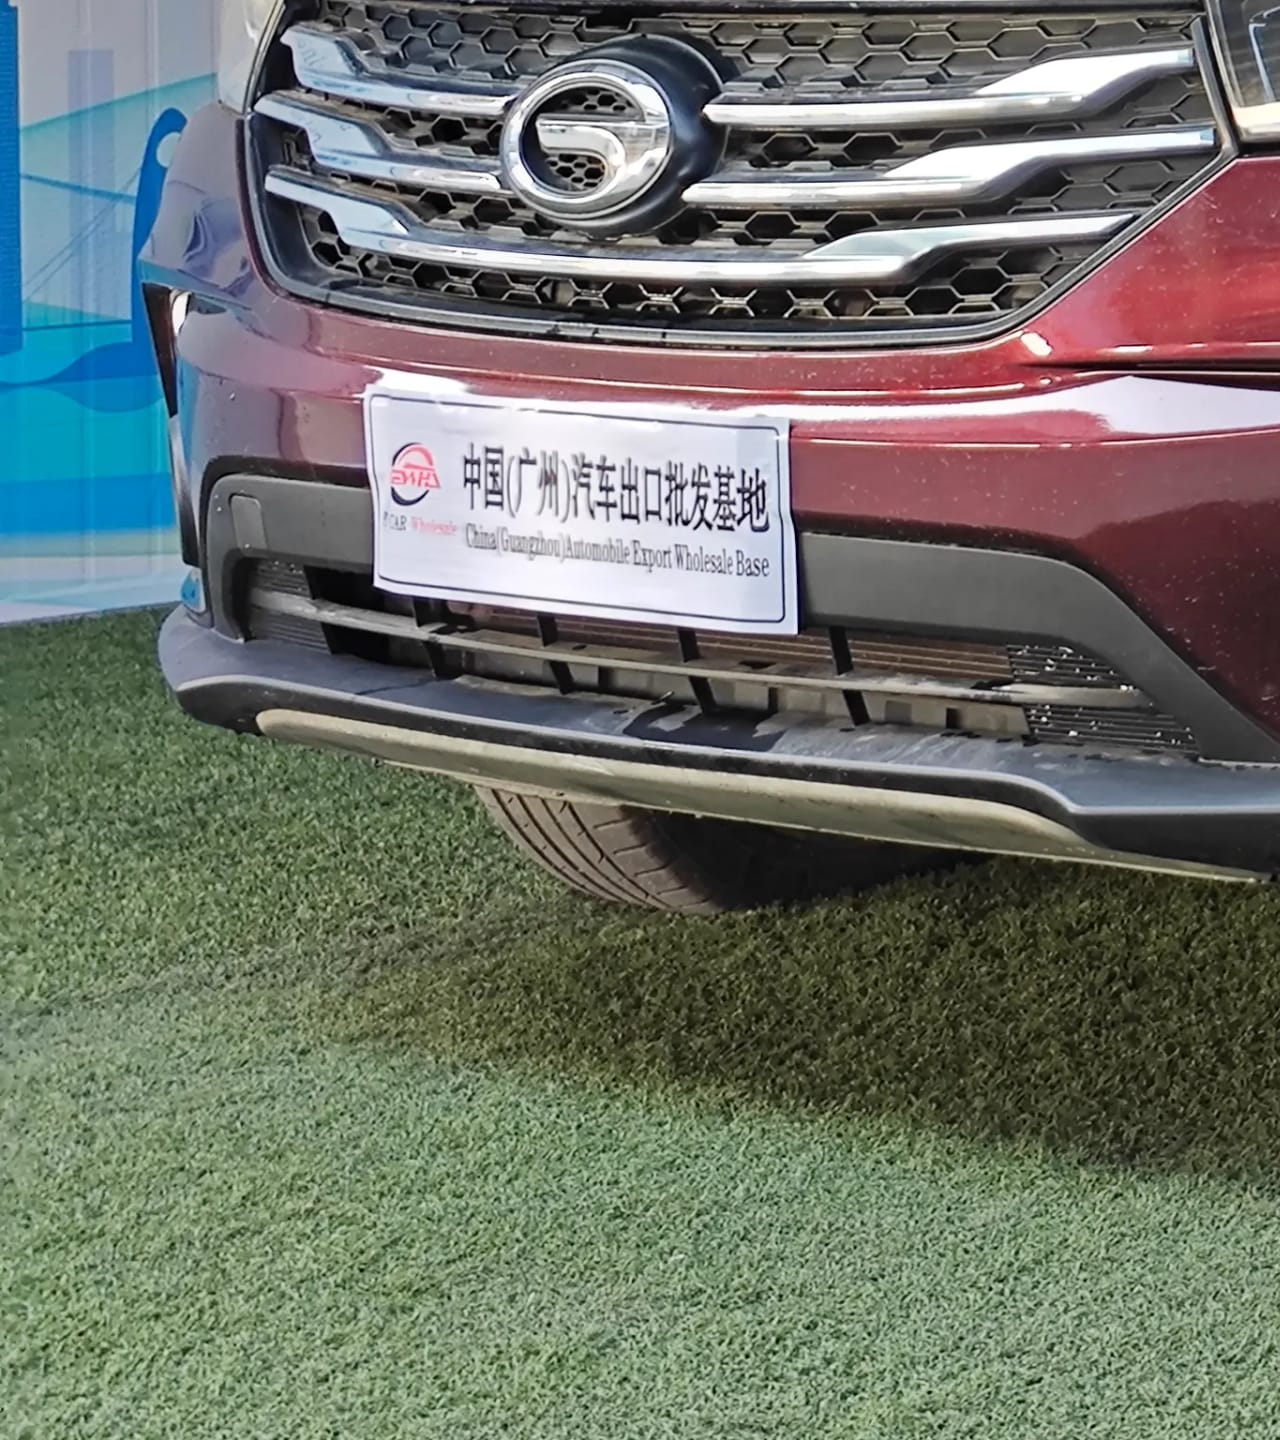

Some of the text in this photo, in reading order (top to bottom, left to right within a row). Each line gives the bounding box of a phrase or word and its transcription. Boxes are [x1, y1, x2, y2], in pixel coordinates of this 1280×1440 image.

[463, 441, 770, 534] 中国(广州)汽车出口批发基地
[633, 539, 672, 573] Export
[674, 543, 734, 575] Wholesale
[735, 549, 770, 578] Base
